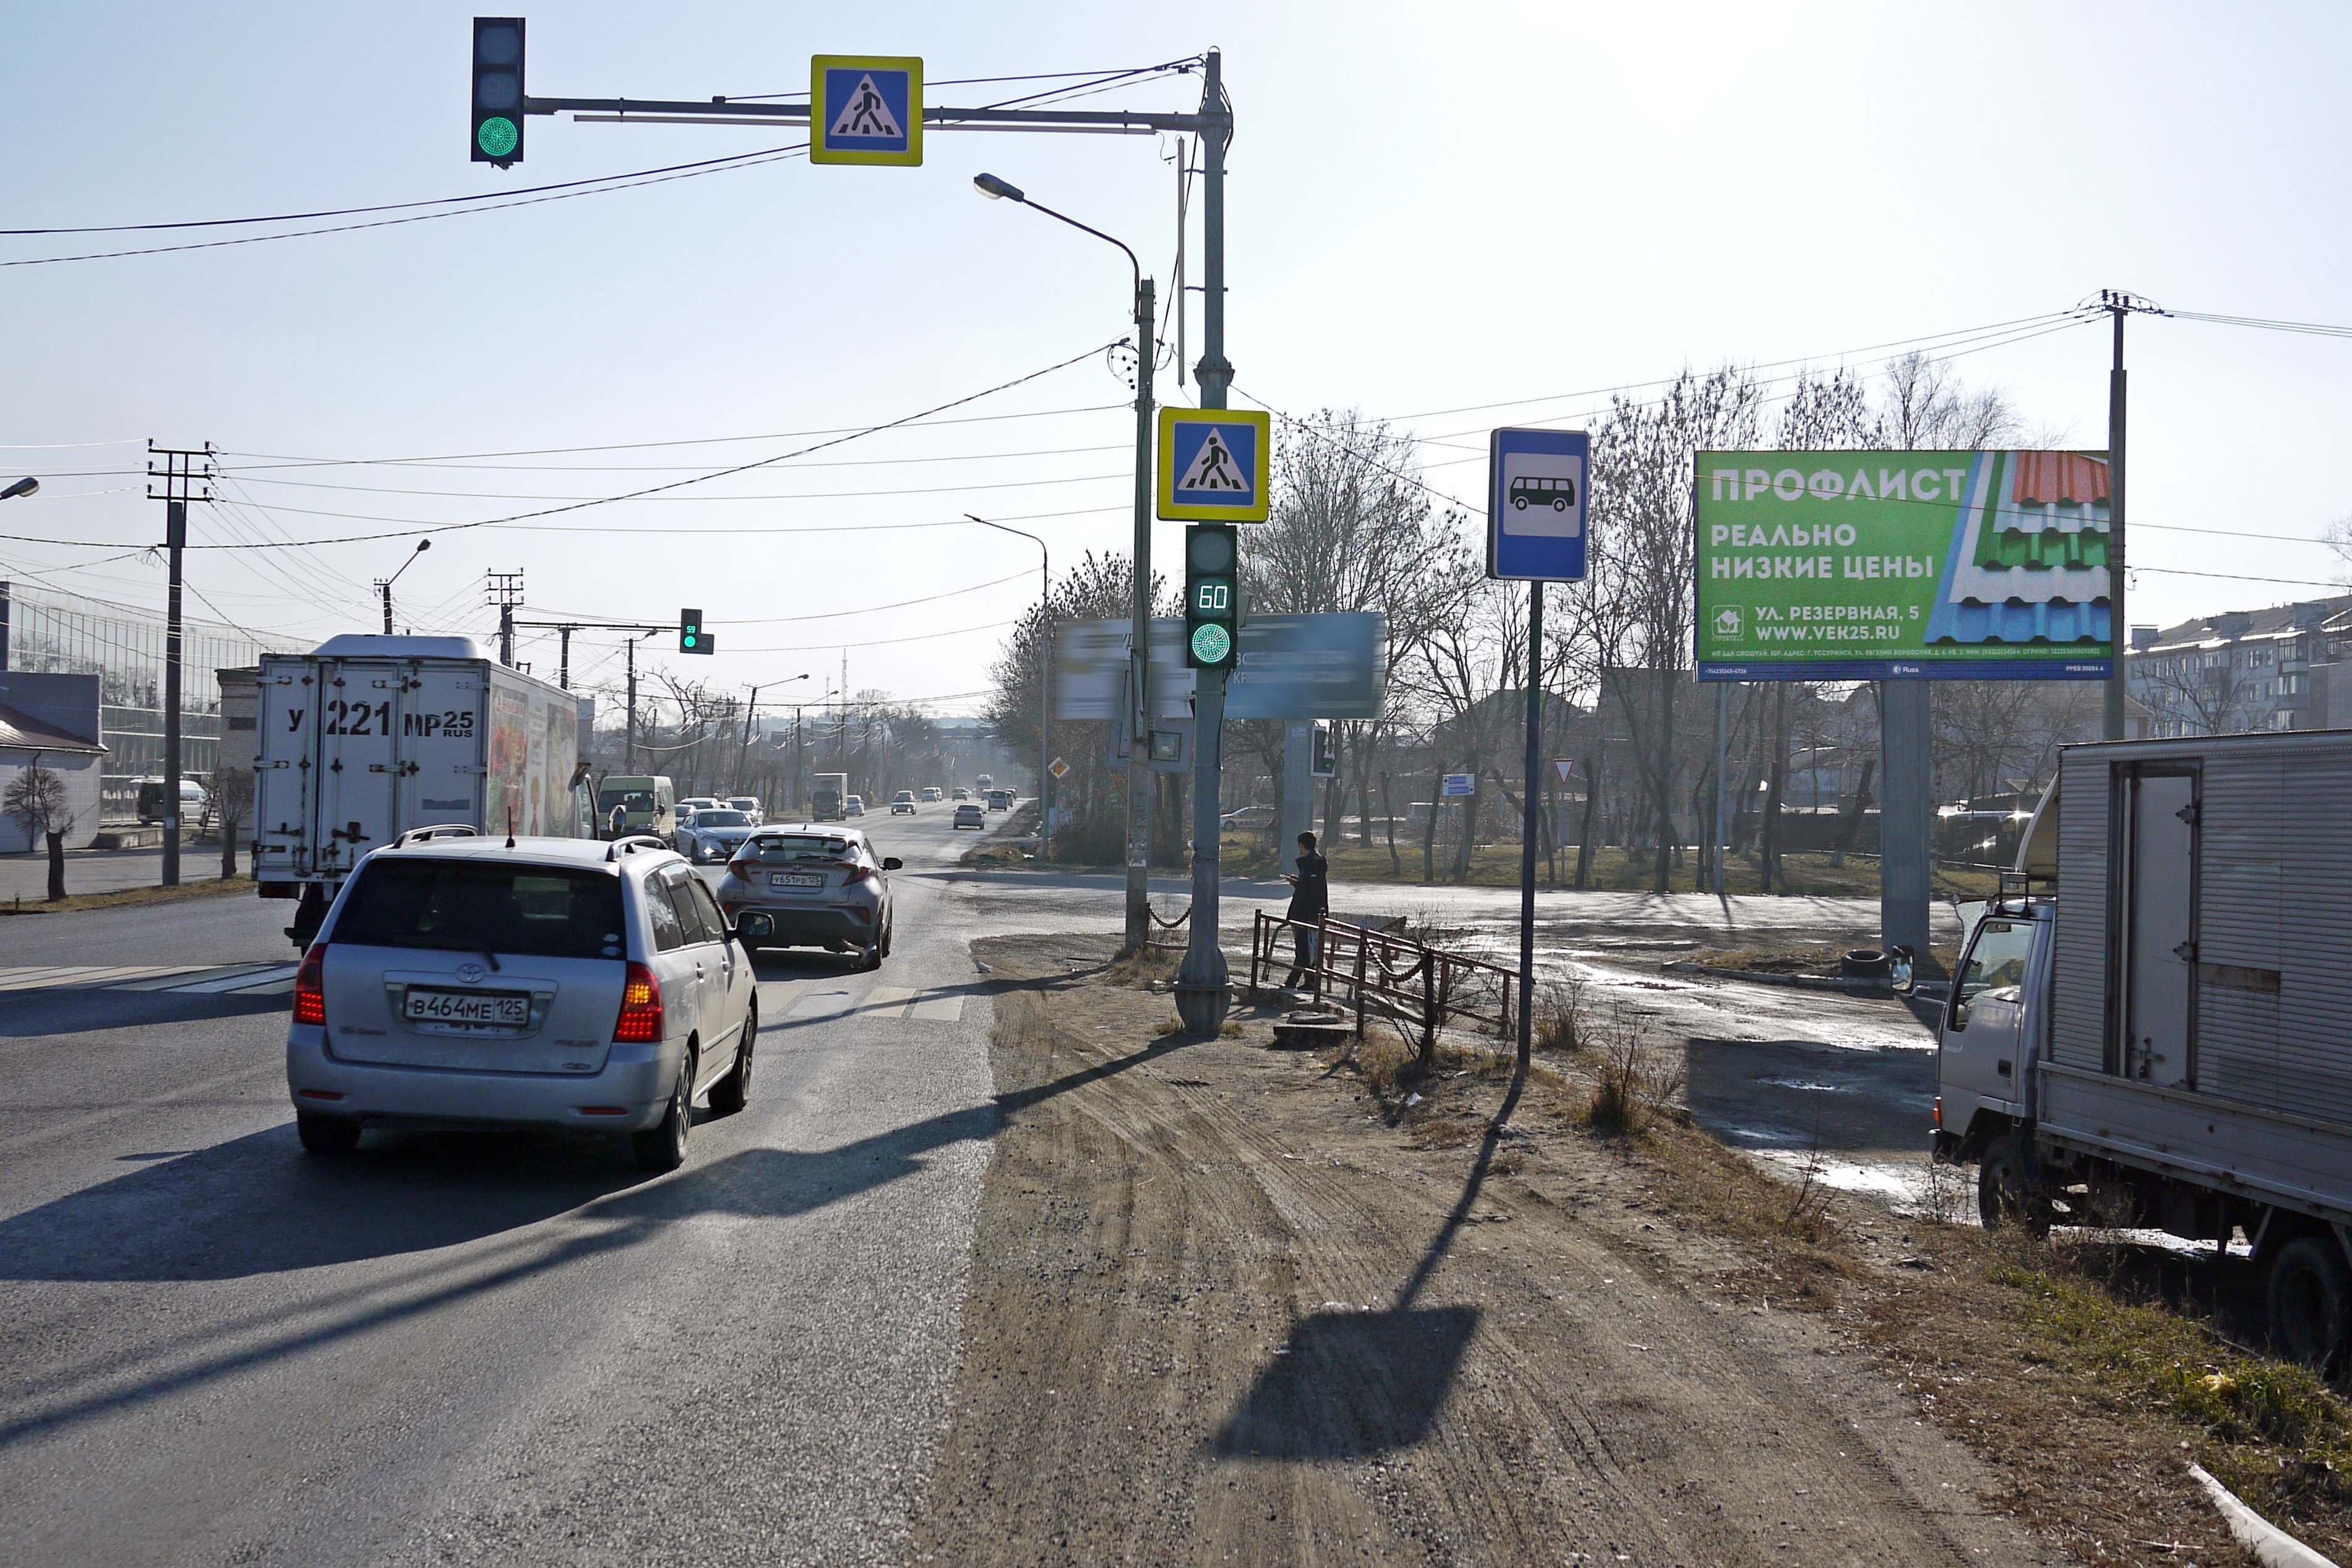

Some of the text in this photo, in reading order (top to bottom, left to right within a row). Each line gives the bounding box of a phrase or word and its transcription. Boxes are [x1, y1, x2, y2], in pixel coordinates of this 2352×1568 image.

[1712, 468, 1966, 501] ПРОФЛИСТ
[1712, 524, 1856, 547] РЕАЛЬНО
[1712, 555, 1933, 581] НИЗКИЕ ЦЕНЫ
[1199, 585, 1228, 609] 60
[1755, 606, 1919, 622] УЛ. РЕЗЕРВНАЯ, 5
[1755, 626, 1900, 640] WWW.VEK25.RU
[326, 700, 390, 735] 221
[444, 711, 473, 728] 25
[443, 729, 473, 737] RUS
[414, 996, 522, 1019] В464МЕ 125
